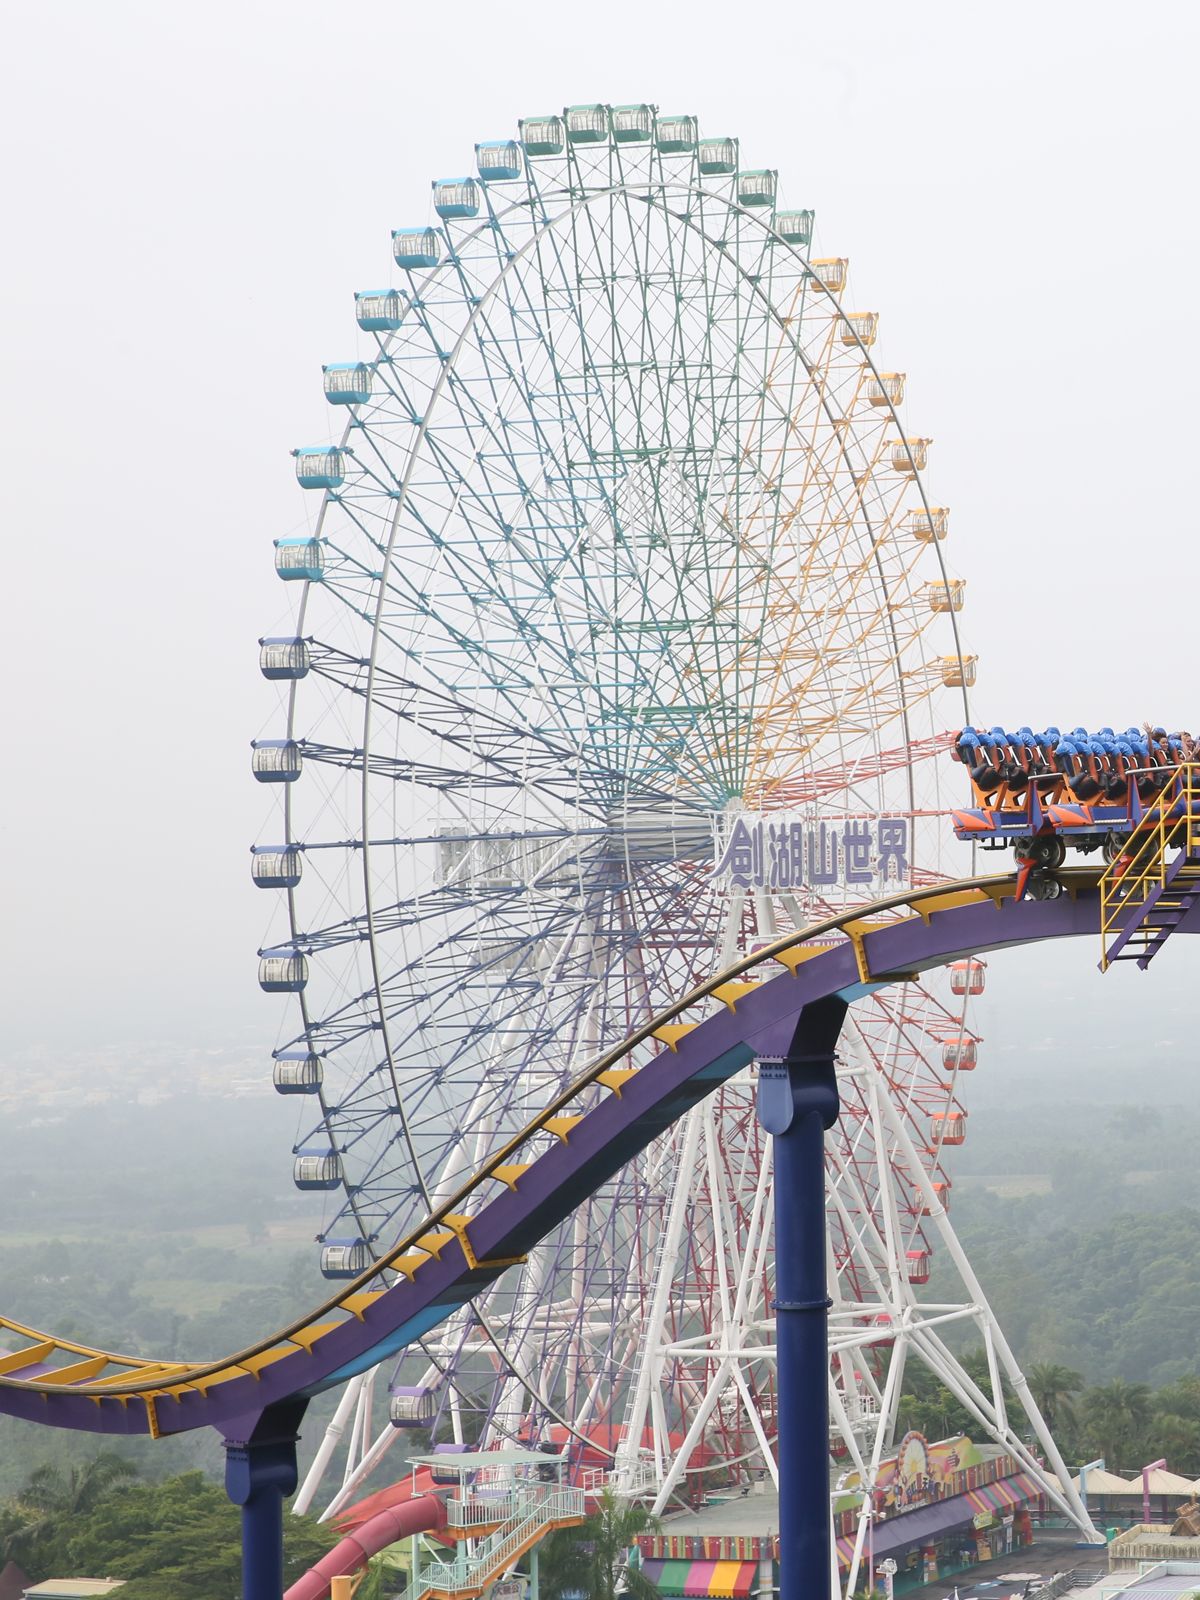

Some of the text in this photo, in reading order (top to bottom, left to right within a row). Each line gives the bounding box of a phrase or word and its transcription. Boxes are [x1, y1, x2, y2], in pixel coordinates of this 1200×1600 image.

[708, 818, 908, 889] 劍湖山世界
